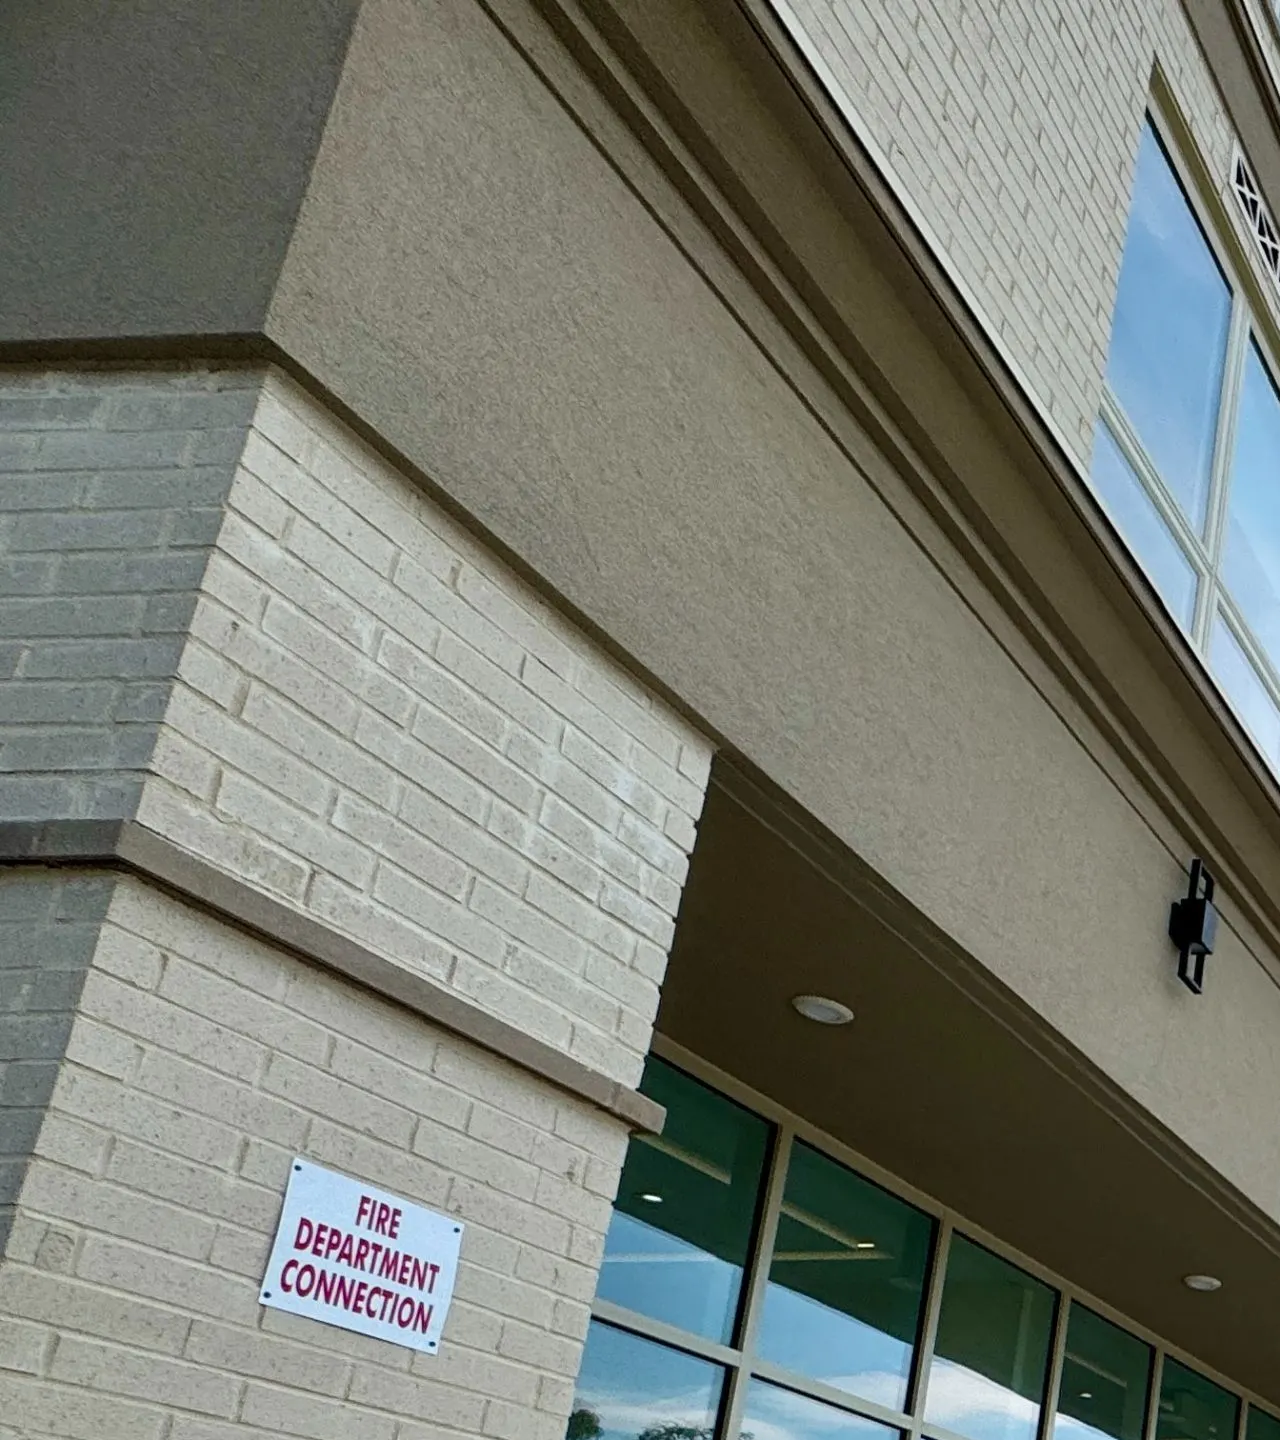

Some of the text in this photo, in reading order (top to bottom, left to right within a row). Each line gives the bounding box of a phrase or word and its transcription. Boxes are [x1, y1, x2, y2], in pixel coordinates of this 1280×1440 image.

[293, 1216, 440, 1294] DEPARTMENT
[355, 1195, 402, 1240] FIRE
[280, 1259, 434, 1335] CONNECTION
